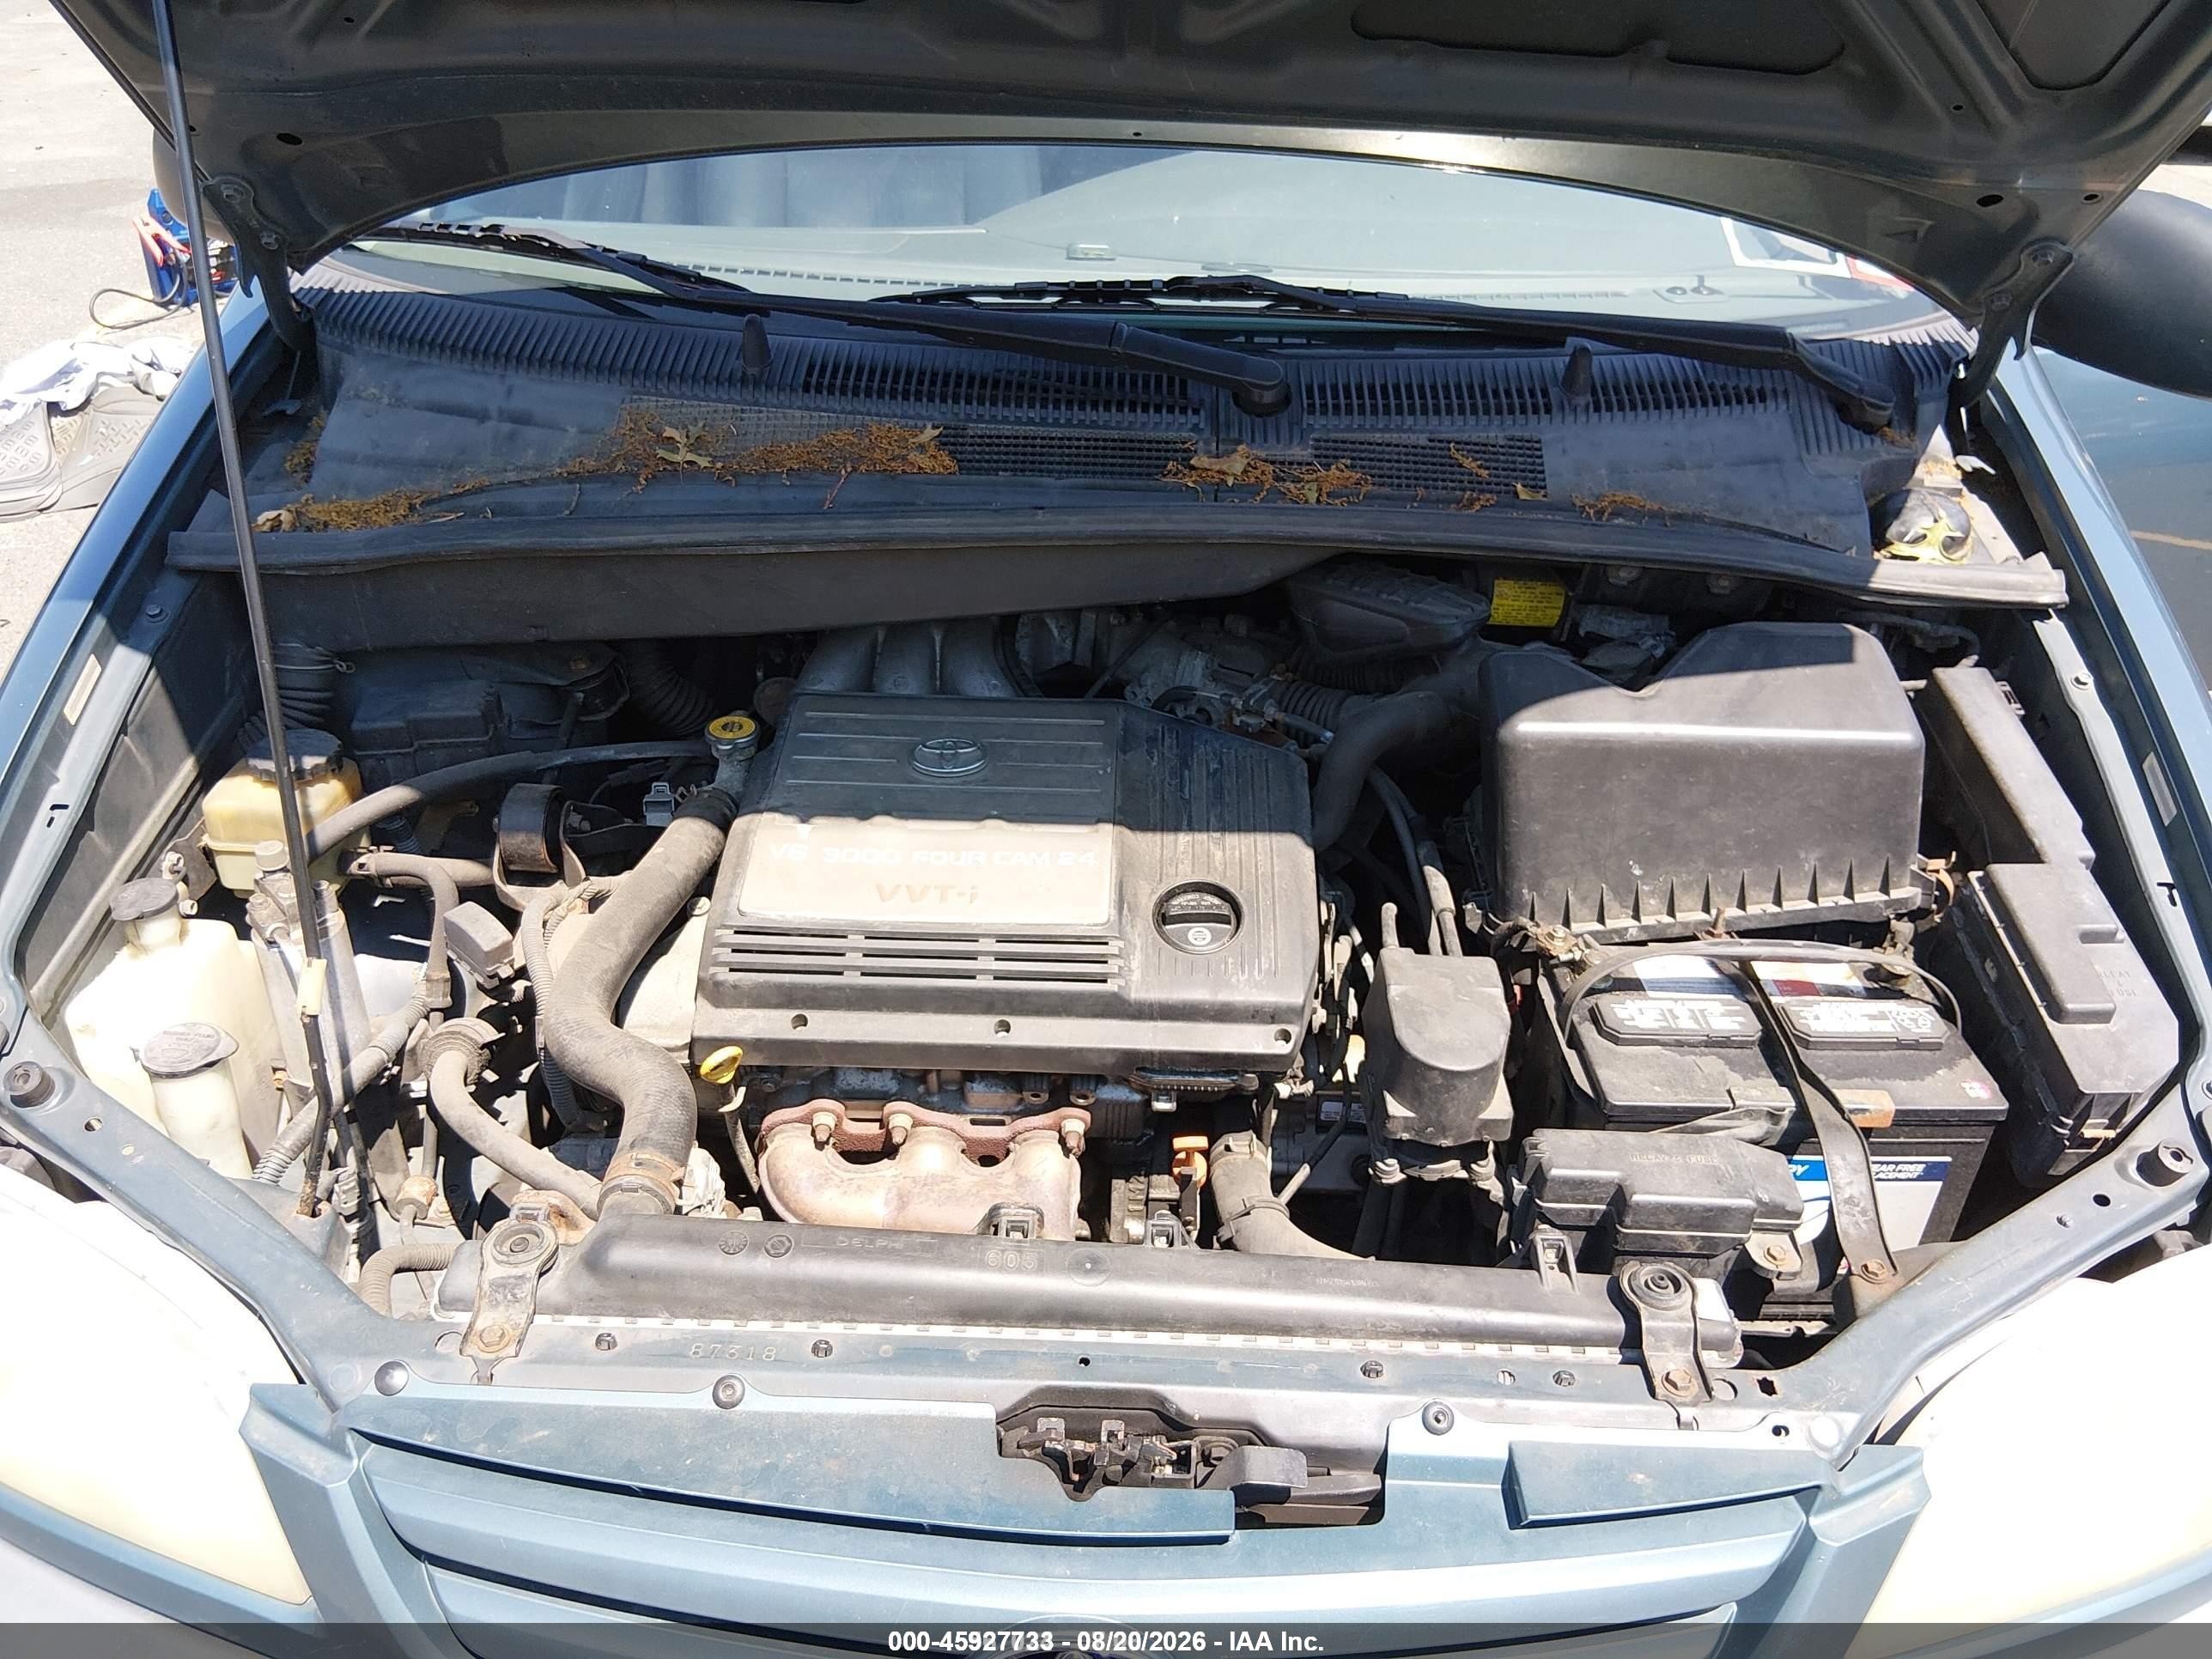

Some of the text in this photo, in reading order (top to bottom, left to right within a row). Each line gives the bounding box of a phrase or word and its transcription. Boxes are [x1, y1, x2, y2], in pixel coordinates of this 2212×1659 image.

[769, 843, 1098, 866] V6 3000 FOUR CAM 24
[875, 883, 979, 904] VVT-i
[1629, 1153, 1666, 1162] RELAY
[1871, 1164, 1926, 1172] EAR FREE
[984, 1249, 1038, 1272] 605
[690, 1342, 776, 1361] 87318
